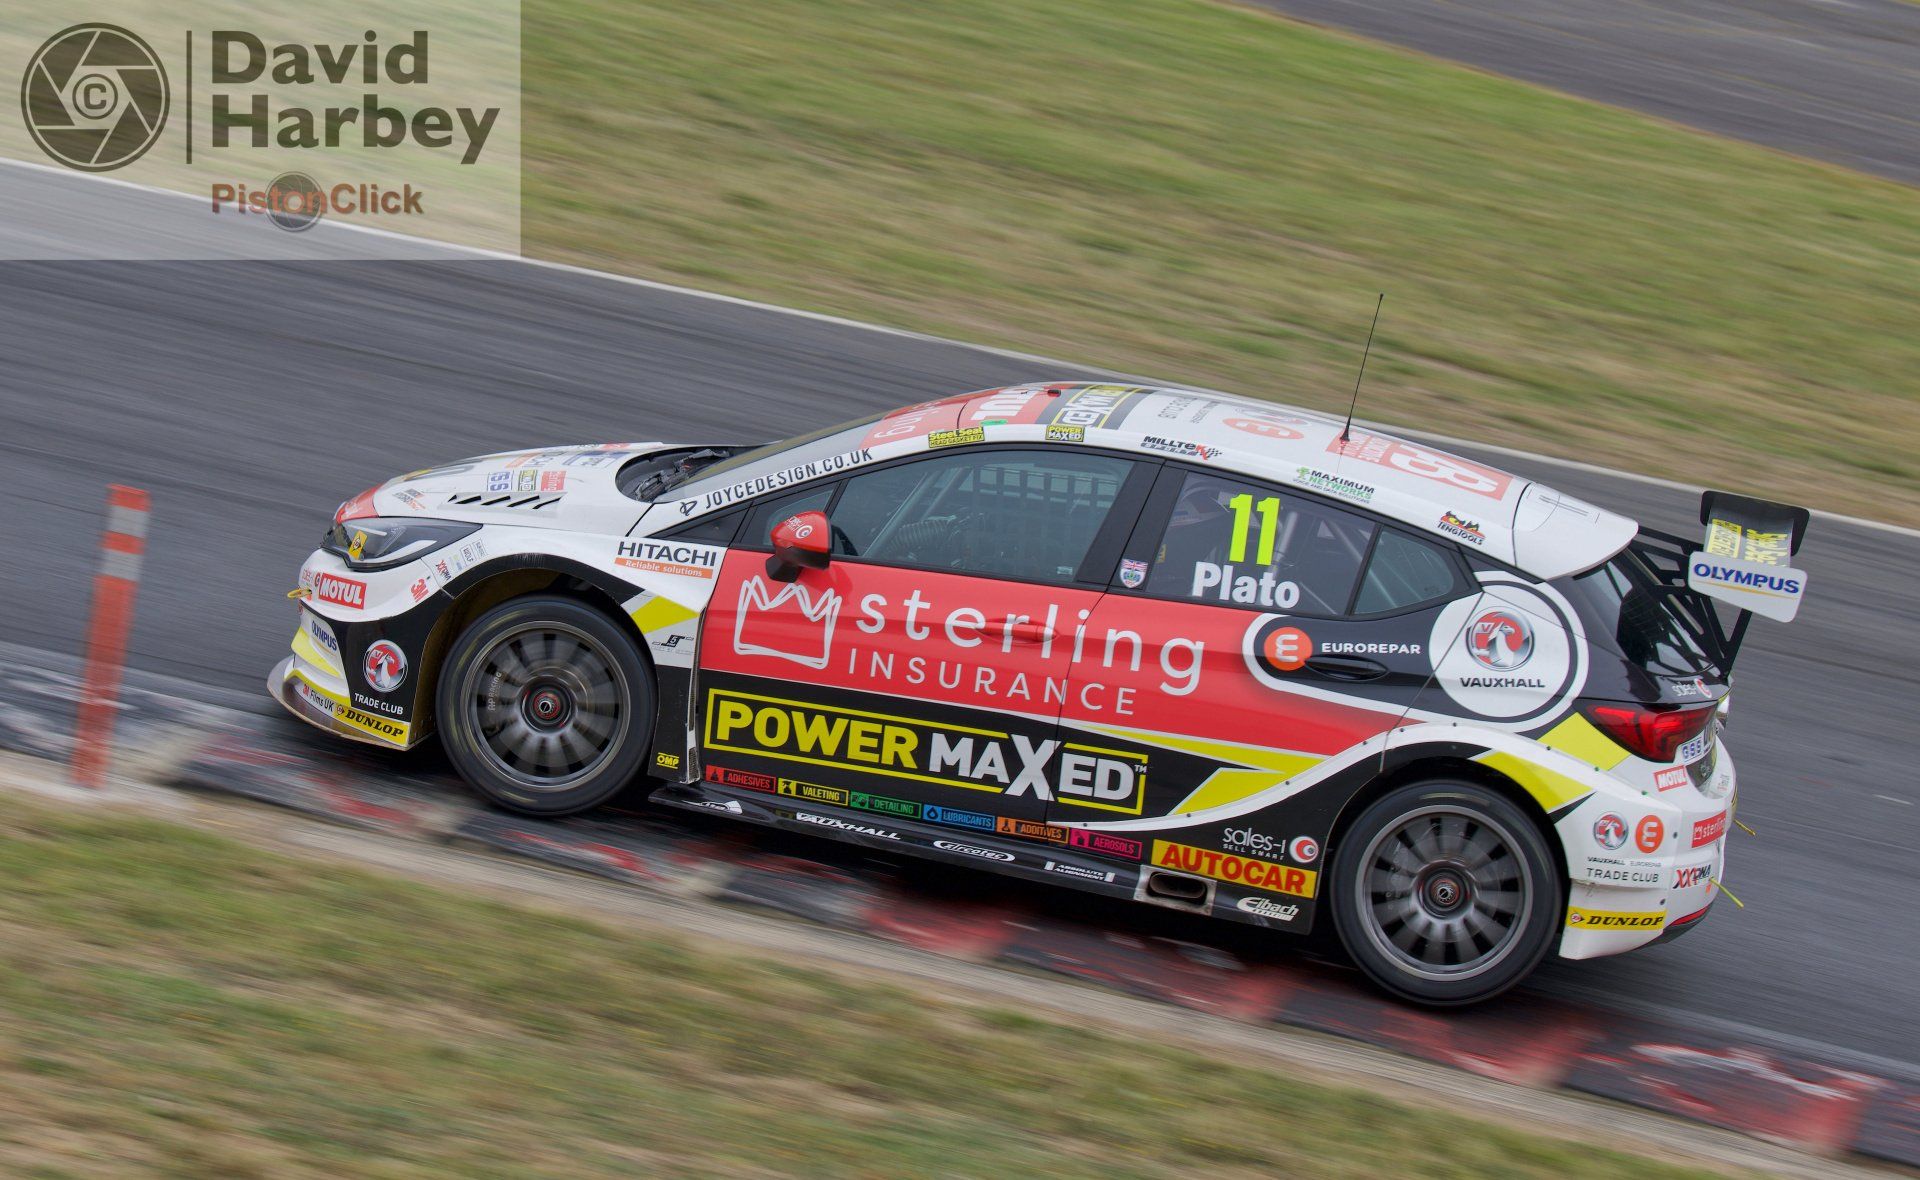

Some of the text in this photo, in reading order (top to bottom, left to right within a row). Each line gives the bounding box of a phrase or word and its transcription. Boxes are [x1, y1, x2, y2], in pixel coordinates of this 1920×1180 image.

[1048, 426, 1082, 434] POWER
[1048, 432, 1081, 441] MAXED
[705, 448, 873, 509] JOYCEDESIGN.CO.UK
[1308, 476, 1372, 500] NETWORKS
[1311, 470, 1375, 494] MAXIMUM
[1228, 493, 1281, 567] 11
[617, 541, 717, 567] HITACHI
[625, 560, 703, 578] Reliable solutions
[1694, 563, 1800, 594] OLYMPUS
[320, 578, 363, 605] MOTUL
[1192, 561, 1300, 609] Plato
[311, 620, 338, 651] OLYMPUS
[856, 590, 1205, 697] sterling
[1321, 642, 1421, 655] EUROREPAR
[848, 648, 1138, 716] INSURANCE
[1460, 676, 1546, 688] VAUXHALL
[354, 692, 404, 716] TRADE CLUB
[345, 709, 404, 737] DUNLOP
[716, 700, 919, 770] POWER
[657, 755, 679, 767] OMP
[727, 772, 771, 789] ADHESIVES
[1658, 768, 1686, 789] MOTUL
[802, 785, 840, 802] VALETING
[874, 799, 914, 815] DETAILING
[796, 812, 901, 840] VAUXHALL
[943, 811, 992, 828] LUBRICANTS
[1020, 825, 1063, 840] ADDITIVES
[1093, 837, 1136, 854] AEROSOLS
[1222, 843, 1284, 860] SELL SMART
[1160, 844, 1306, 894] AUTOCAR
[1587, 856, 1626, 866] VAUXHALL
[1586, 867, 1660, 883] TRADE CLUB
[1587, 915, 1664, 926] DUNLOP
